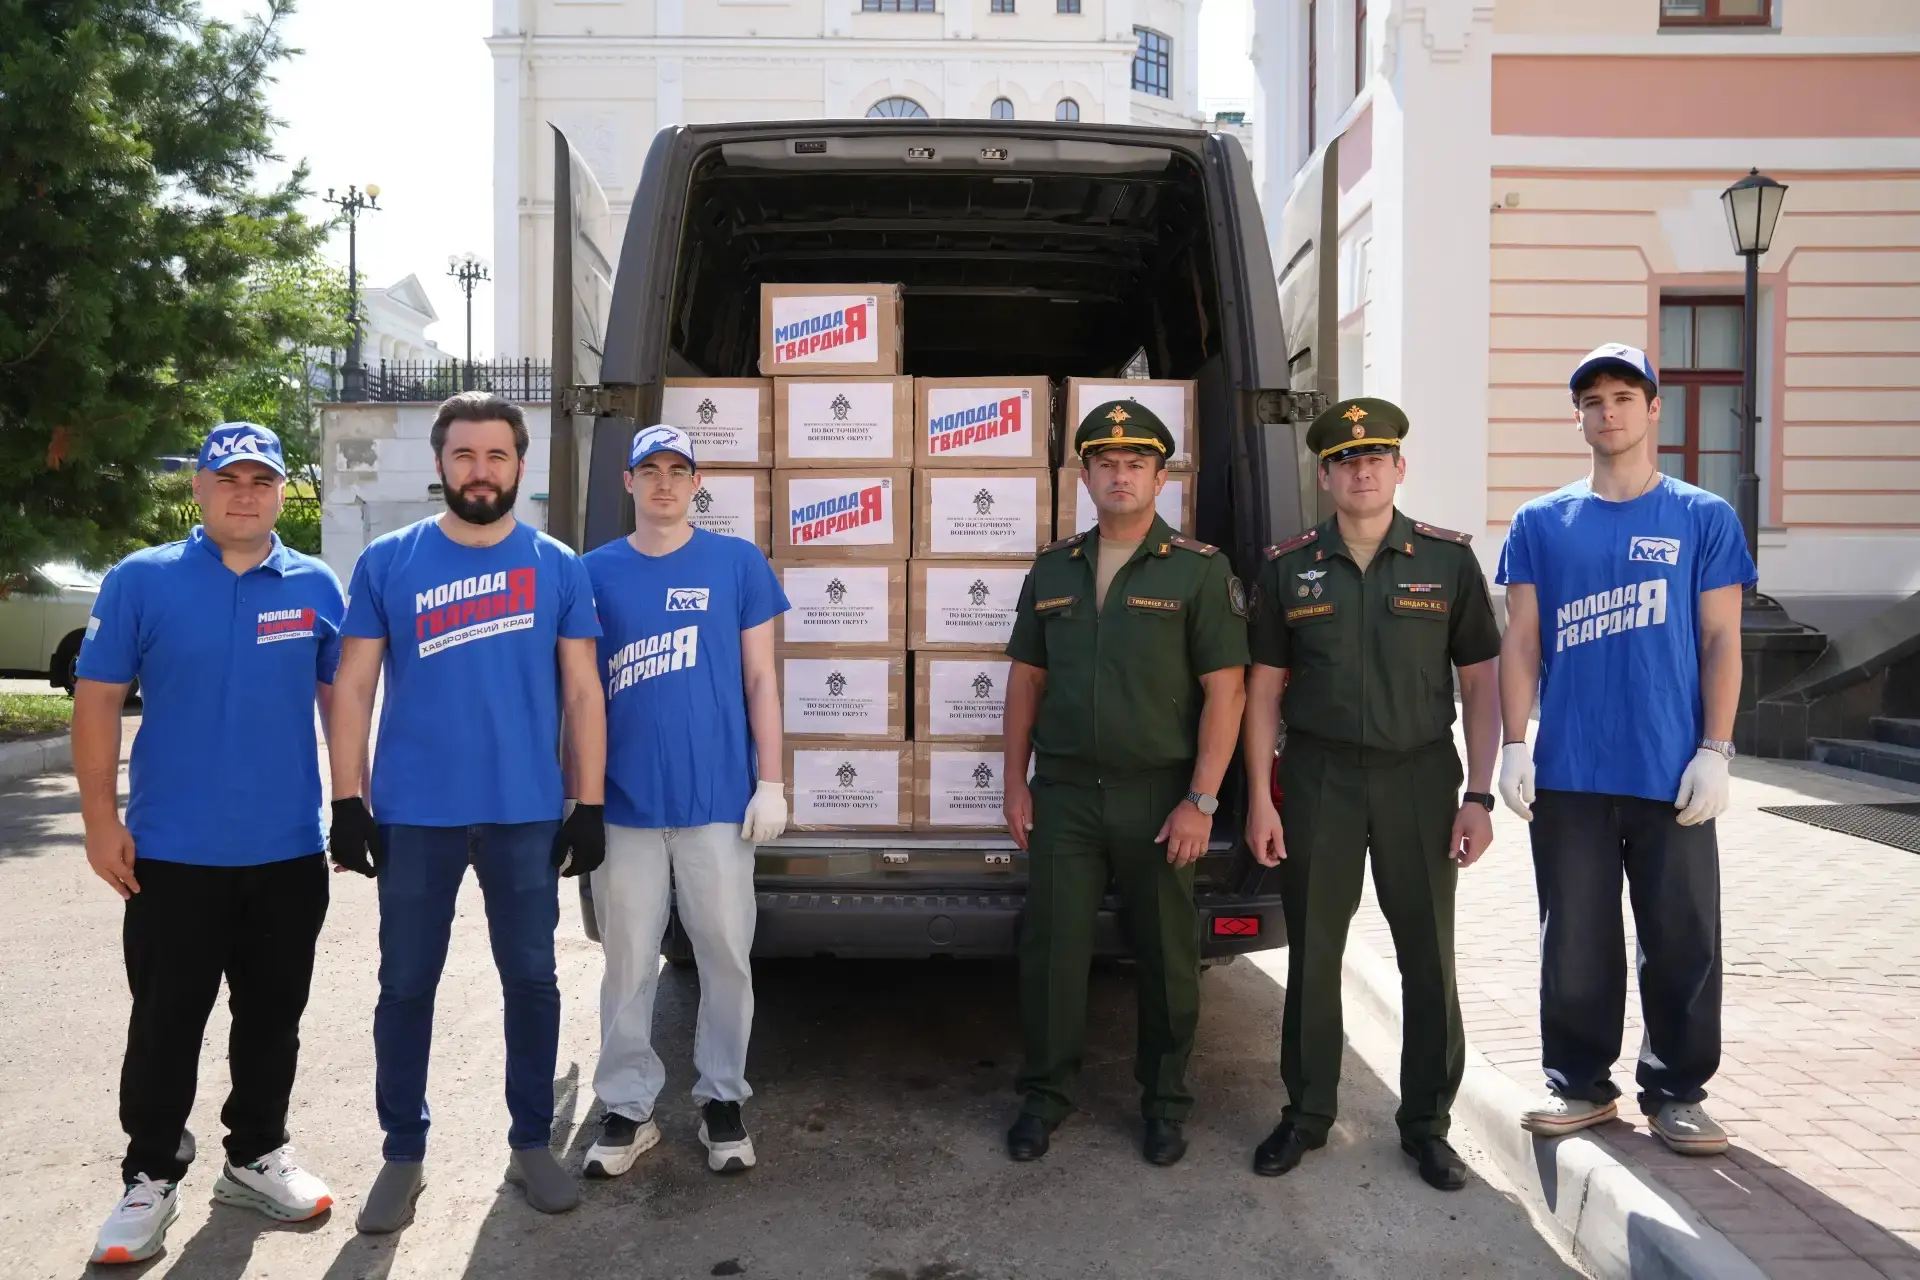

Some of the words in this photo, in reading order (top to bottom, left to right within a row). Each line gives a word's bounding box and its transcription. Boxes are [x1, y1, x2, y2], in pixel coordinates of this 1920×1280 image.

[776, 304, 866, 344] МОЛОДАЯ
[930, 396, 1021, 436] МОЛОДАЯ
[791, 486, 882, 526] МОЛОДАЯ
[416, 568, 535, 616] МОЛОДАЯ
[1399, 599, 1429, 608] БОНДАРЬ
[1557, 579, 1667, 629] МОЛОДАЯ
[421, 624, 500, 654] ХАБАРОВСКИЙ
[608, 625, 698, 678] МОЛОДАЯ
